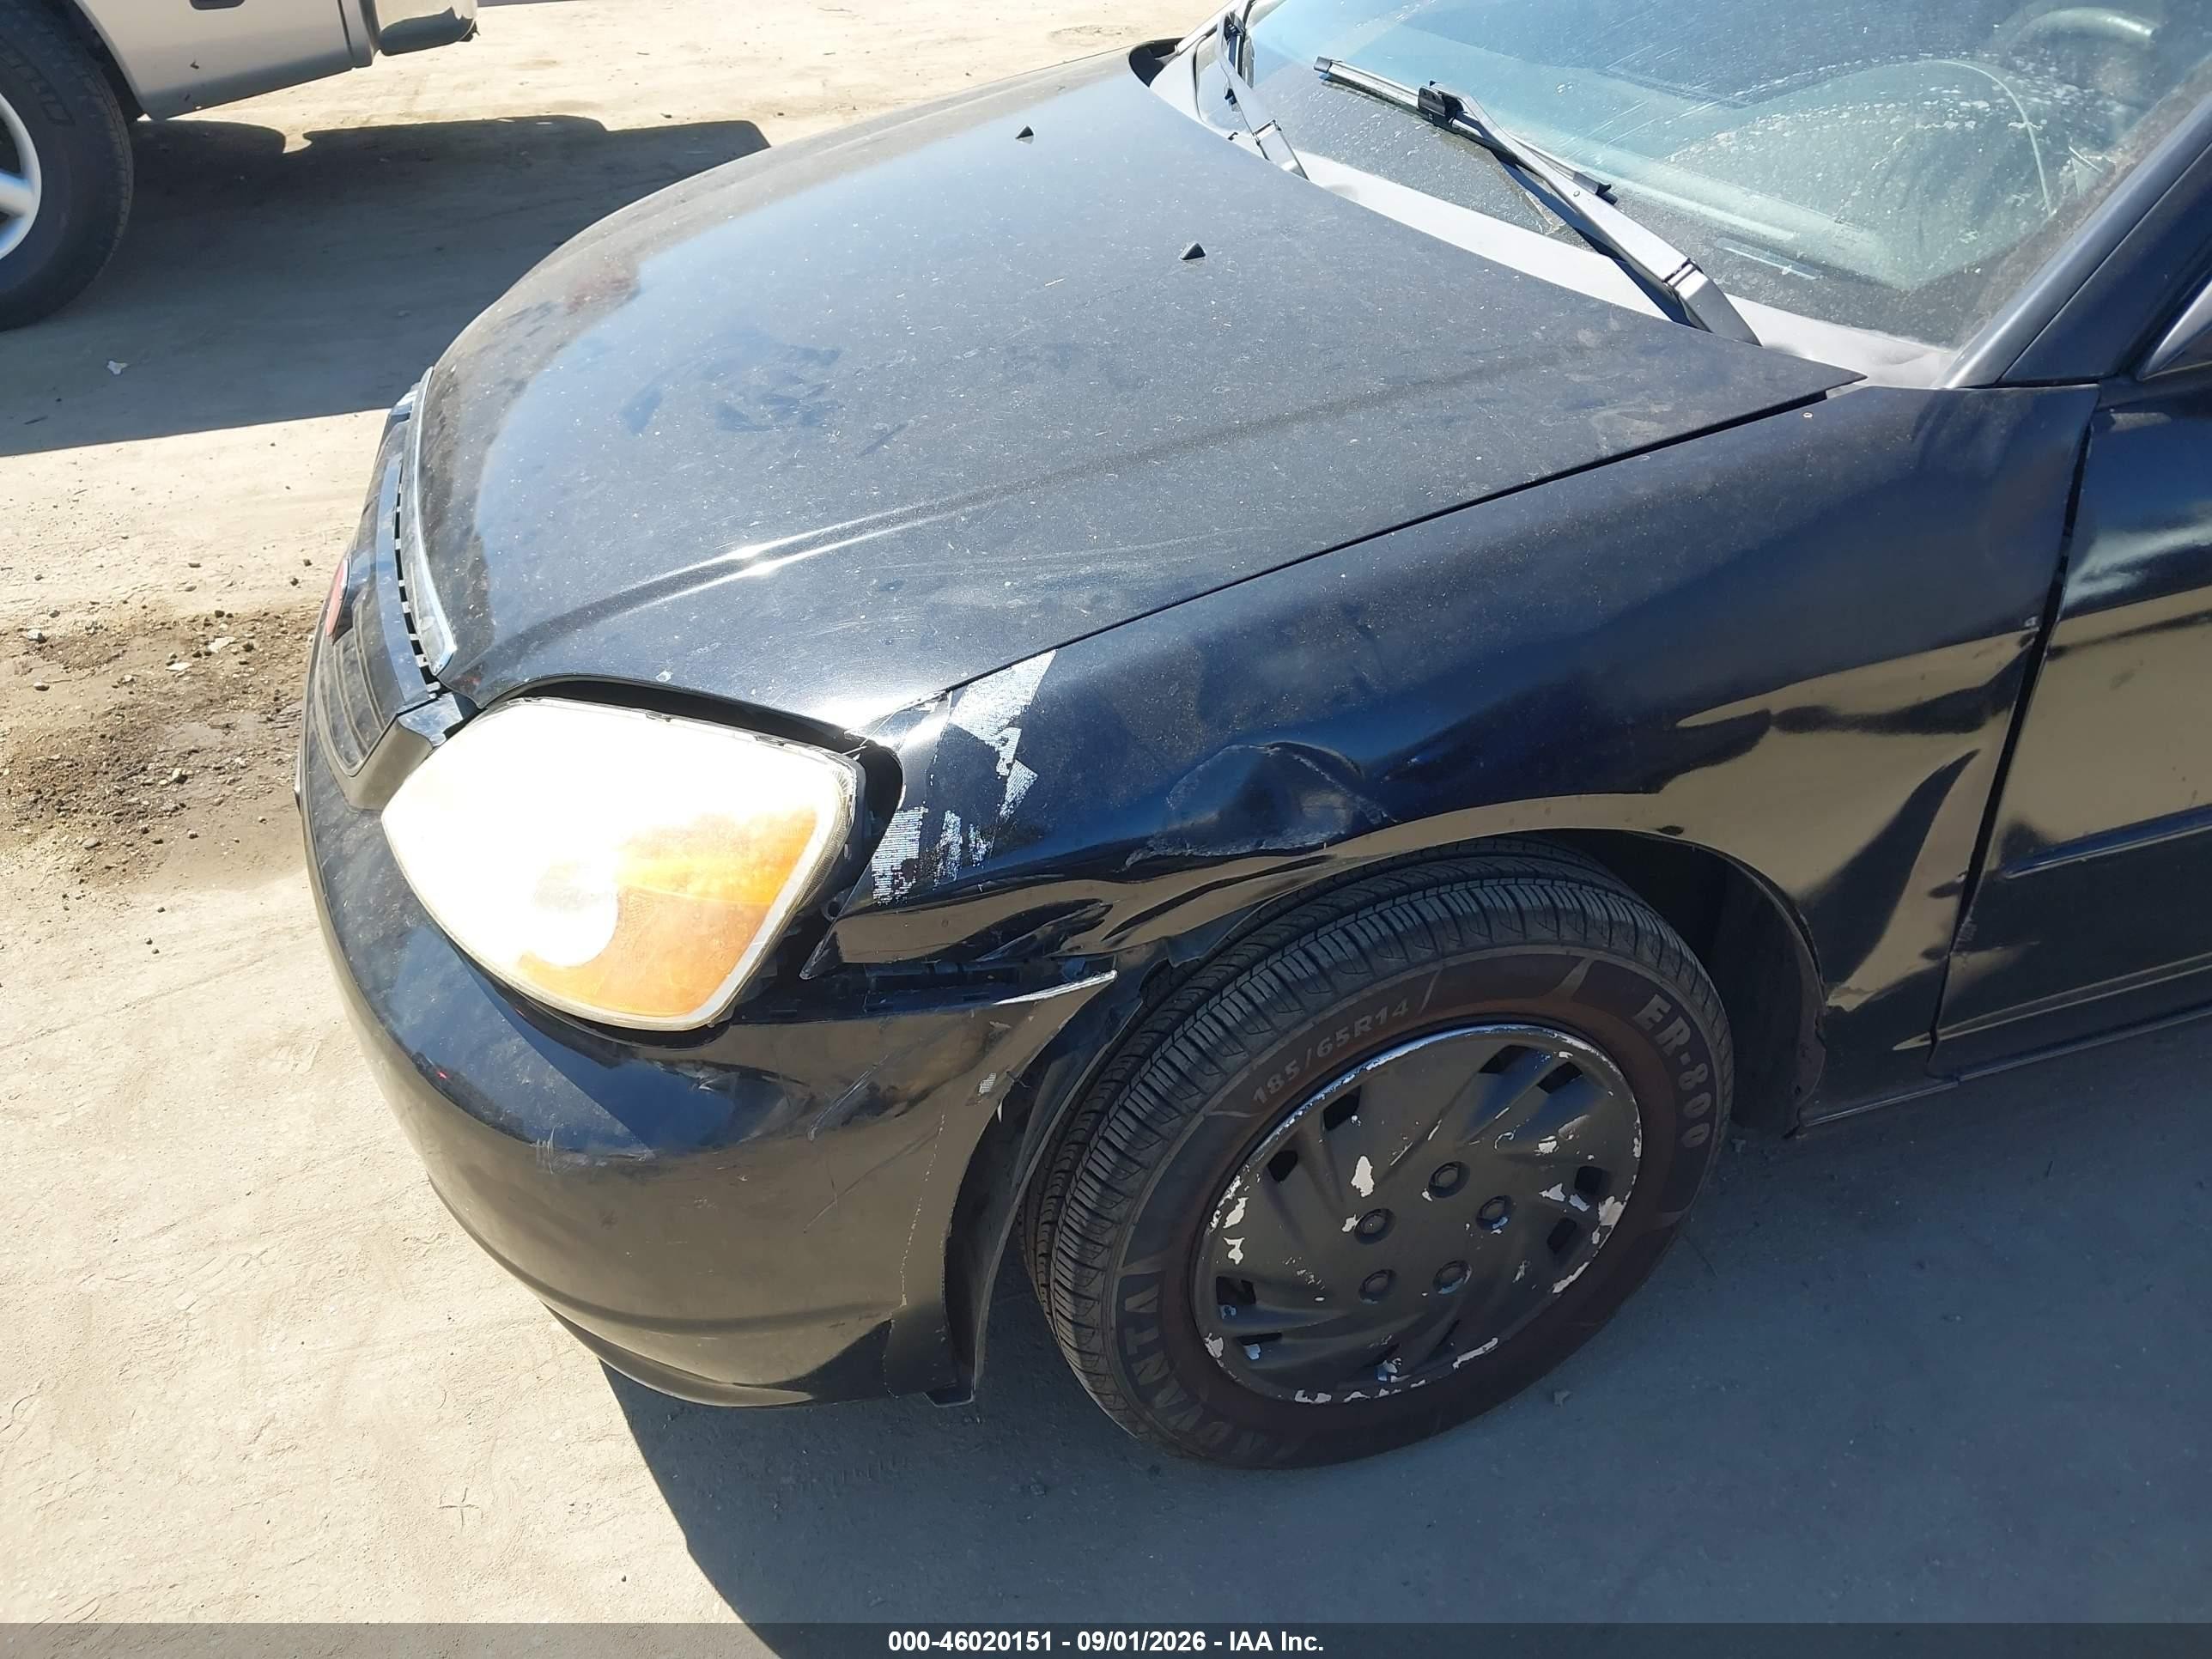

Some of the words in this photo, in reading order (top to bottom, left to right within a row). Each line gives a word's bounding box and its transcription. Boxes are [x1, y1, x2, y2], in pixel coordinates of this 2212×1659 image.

[1252, 998, 1410, 1104] 185/65R14
[1633, 993, 1712, 1148] ER-800
[1122, 1284, 1270, 1456] ADVANTA
